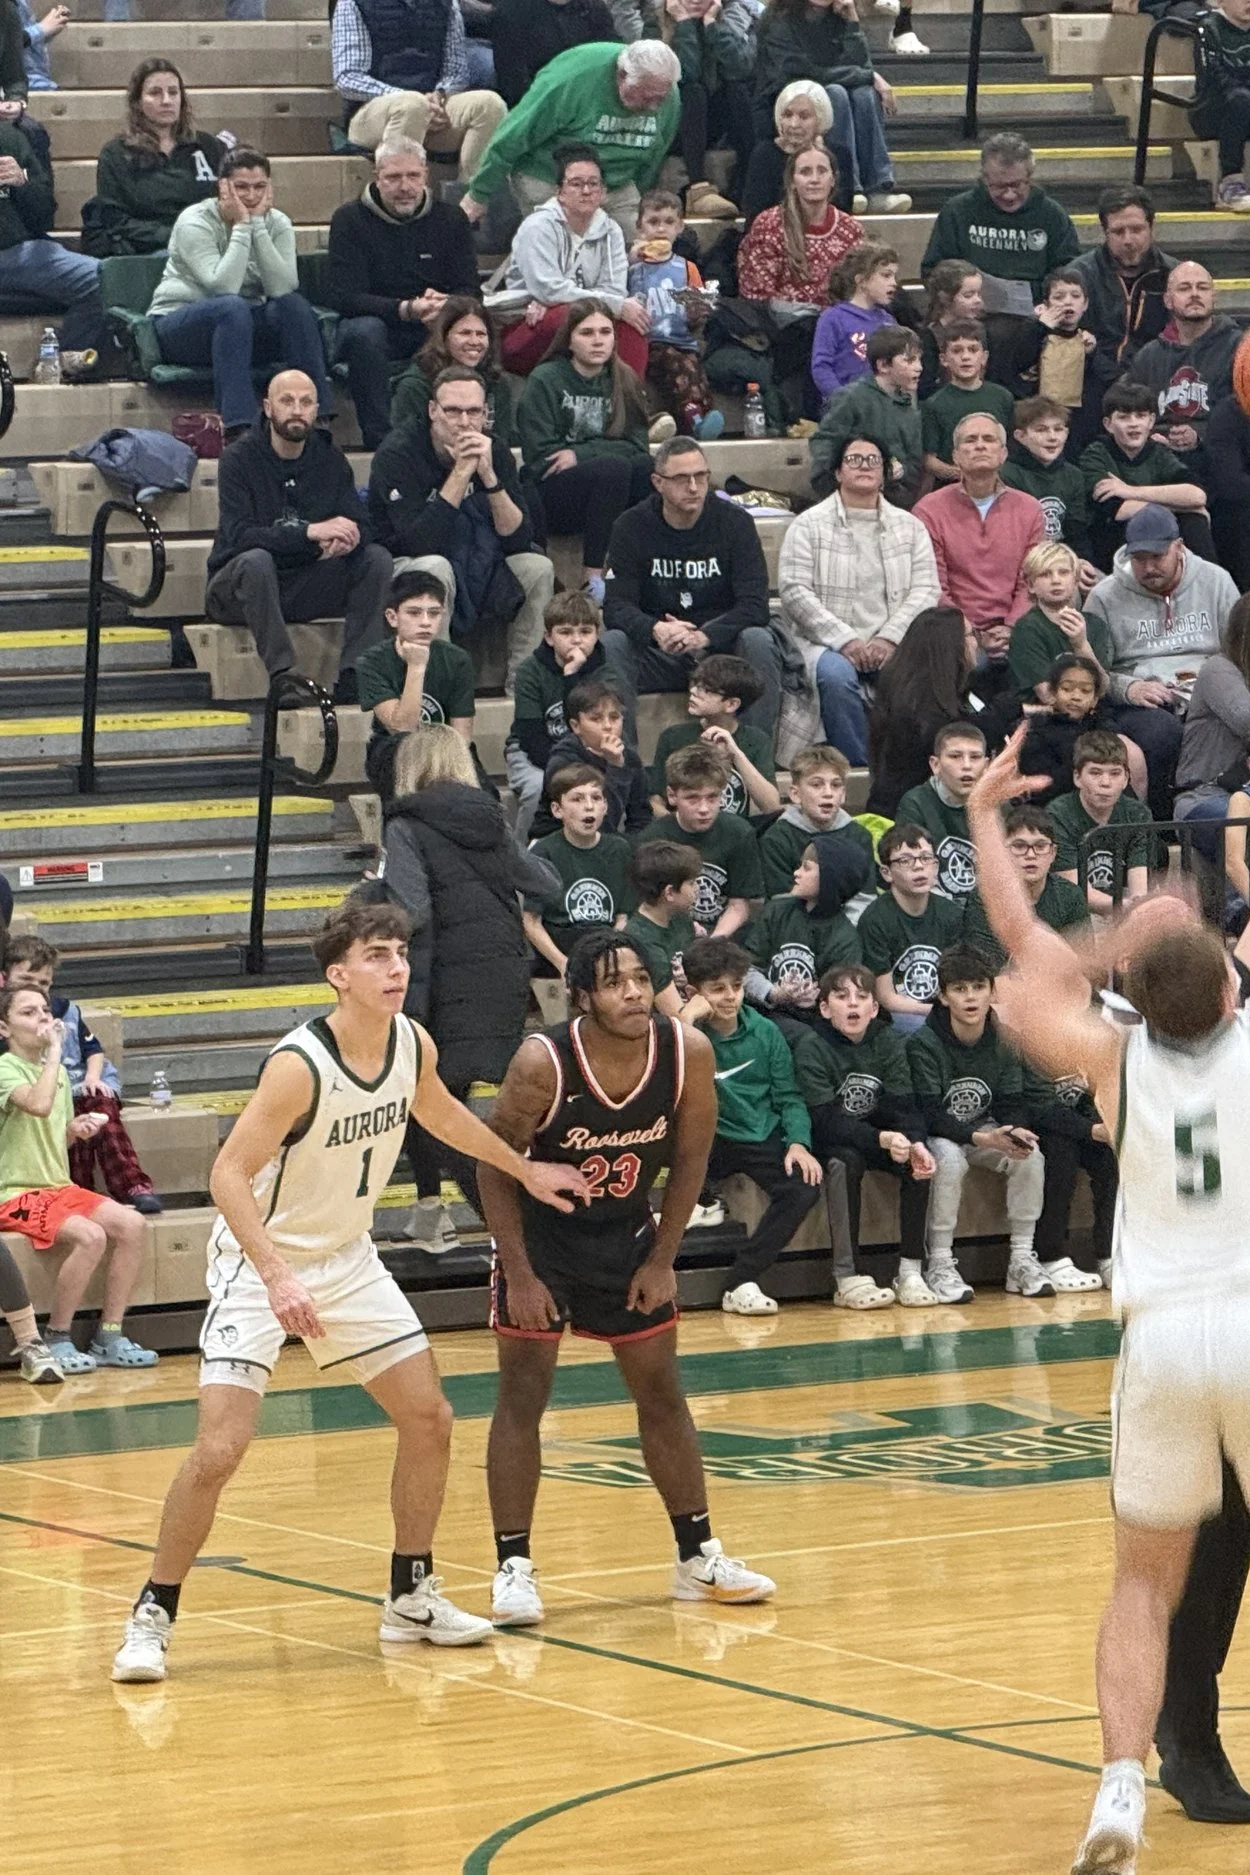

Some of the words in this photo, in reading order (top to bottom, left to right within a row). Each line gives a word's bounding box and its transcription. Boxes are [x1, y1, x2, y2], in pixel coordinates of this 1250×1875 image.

[192, 150, 219, 181] A
[968, 224, 1027, 241] AURORA
[651, 557, 722, 579] AURORA
[1137, 611, 1212, 641] AURORA
[325, 1097, 407, 1148] AURORA
[560, 1115, 667, 1150] Roosevelt
[356, 1147, 374, 1197] 1
[581, 1153, 642, 1199] 23
